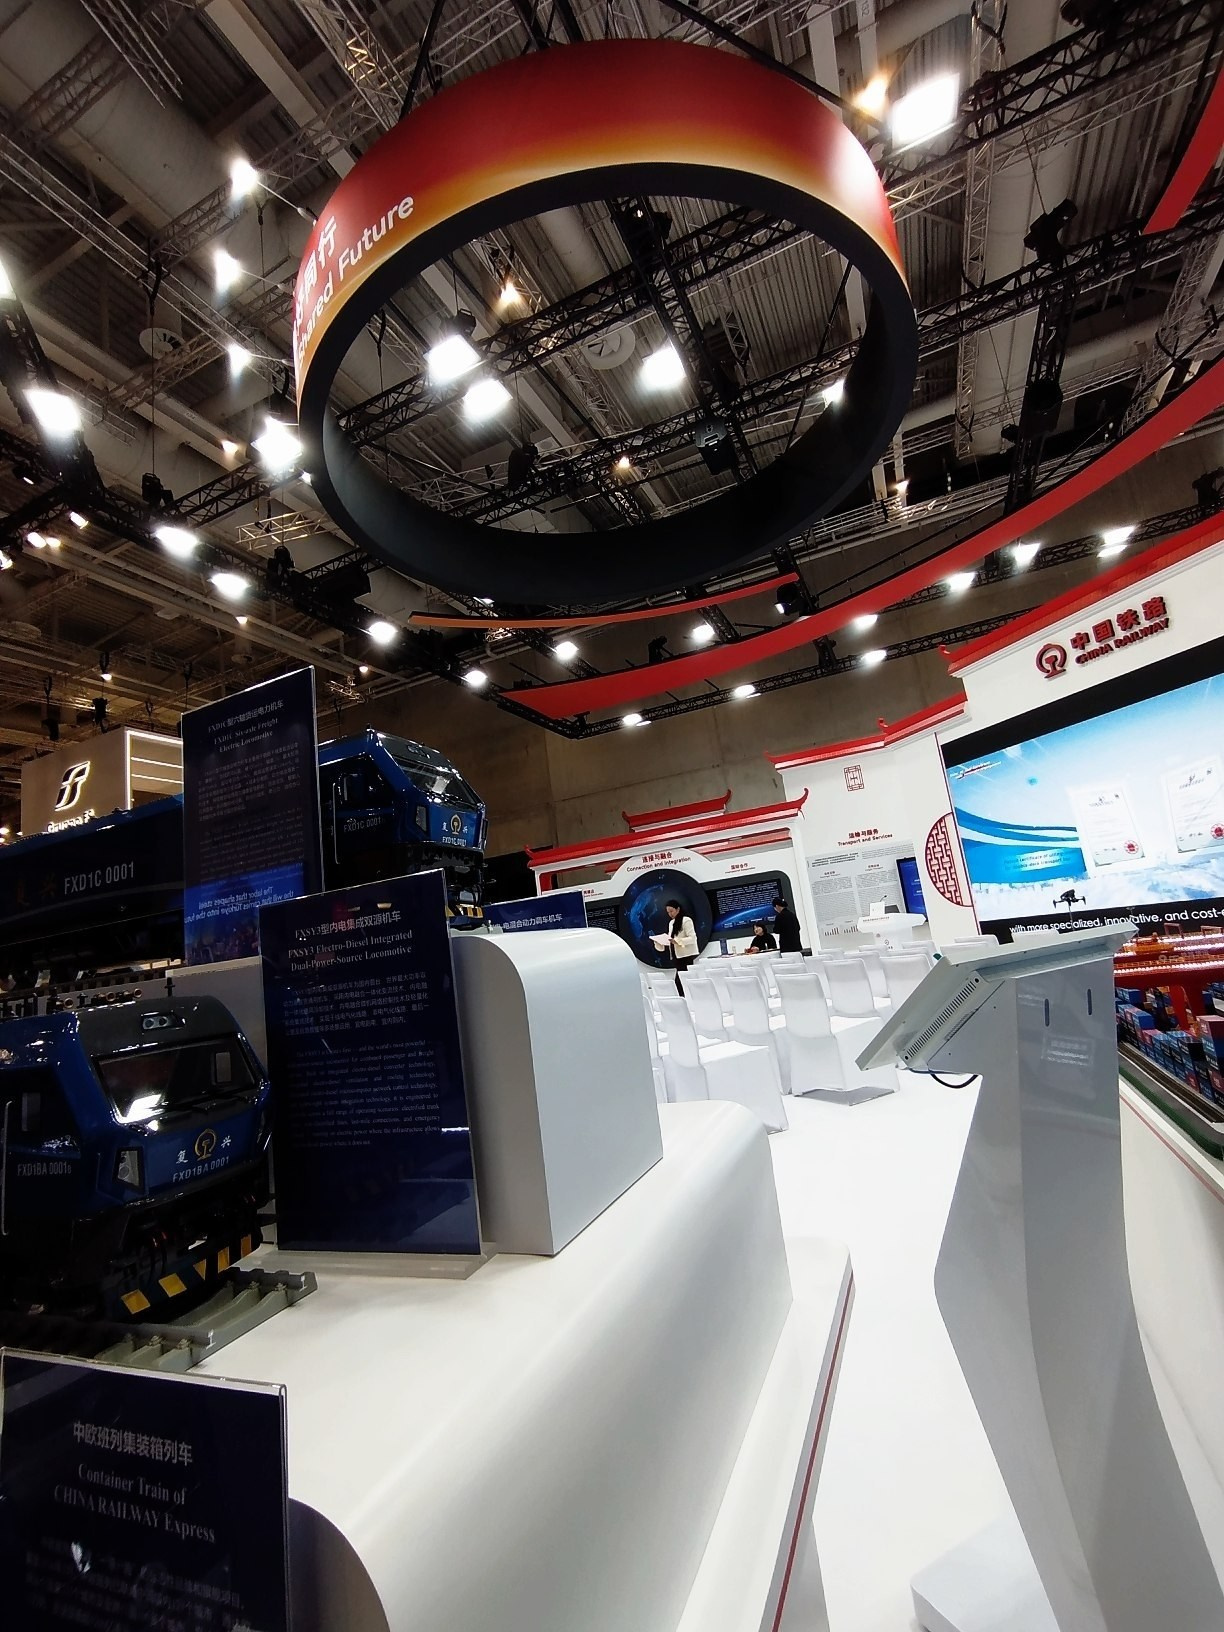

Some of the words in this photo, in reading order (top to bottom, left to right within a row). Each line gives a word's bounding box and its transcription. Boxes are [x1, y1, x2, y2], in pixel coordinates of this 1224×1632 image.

[338, 196, 414, 281] Future
[1070, 596, 1168, 650] 中国铁路
[1075, 643, 1114, 665] CHINA
[1113, 618, 1170, 649] RAILWAY
[241, 730, 273, 746] Locomotive
[257, 718, 278, 731] Freight
[838, 838, 861, 847] Transport
[872, 833, 893, 841] Services
[626, 863, 653, 873] Connection
[664, 856, 691, 866] Integration
[641, 851, 673, 864] 连接与融合
[64, 870, 101, 895] FXD1C
[105, 861, 134, 884] 0001
[295, 910, 402, 939] FXSY3型内电集成双源机车
[1009, 924, 1027, 934] with
[1026, 923, 1049, 932] more
[1164, 909, 1189, 921] and
[288, 946, 314, 959] FXSY3
[316, 935, 369, 954] Electro-Diesel
[370, 929, 413, 945] Integrated
[291, 954, 363, 972] Dual-Power-Source
[365, 945, 412, 960] Locomotive
[176, 1150, 189, 1165] 复
[220, 1135, 232, 1148] 兴
[17, 1162, 47, 1177] FXD1BA
[172, 1164, 209, 1183] FXD1BA
[210, 1155, 230, 1172] 0001
[73, 1420, 194, 1466] 中欧班列集装箱列车
[78, 1463, 134, 1493] Container
[138, 1478, 170, 1504] Train
[173, 1487, 187, 1505] of
[54, 1485, 96, 1511] CHINA
[98, 1496, 160, 1529] RAILWAY
[164, 1512, 216, 1544] Express
